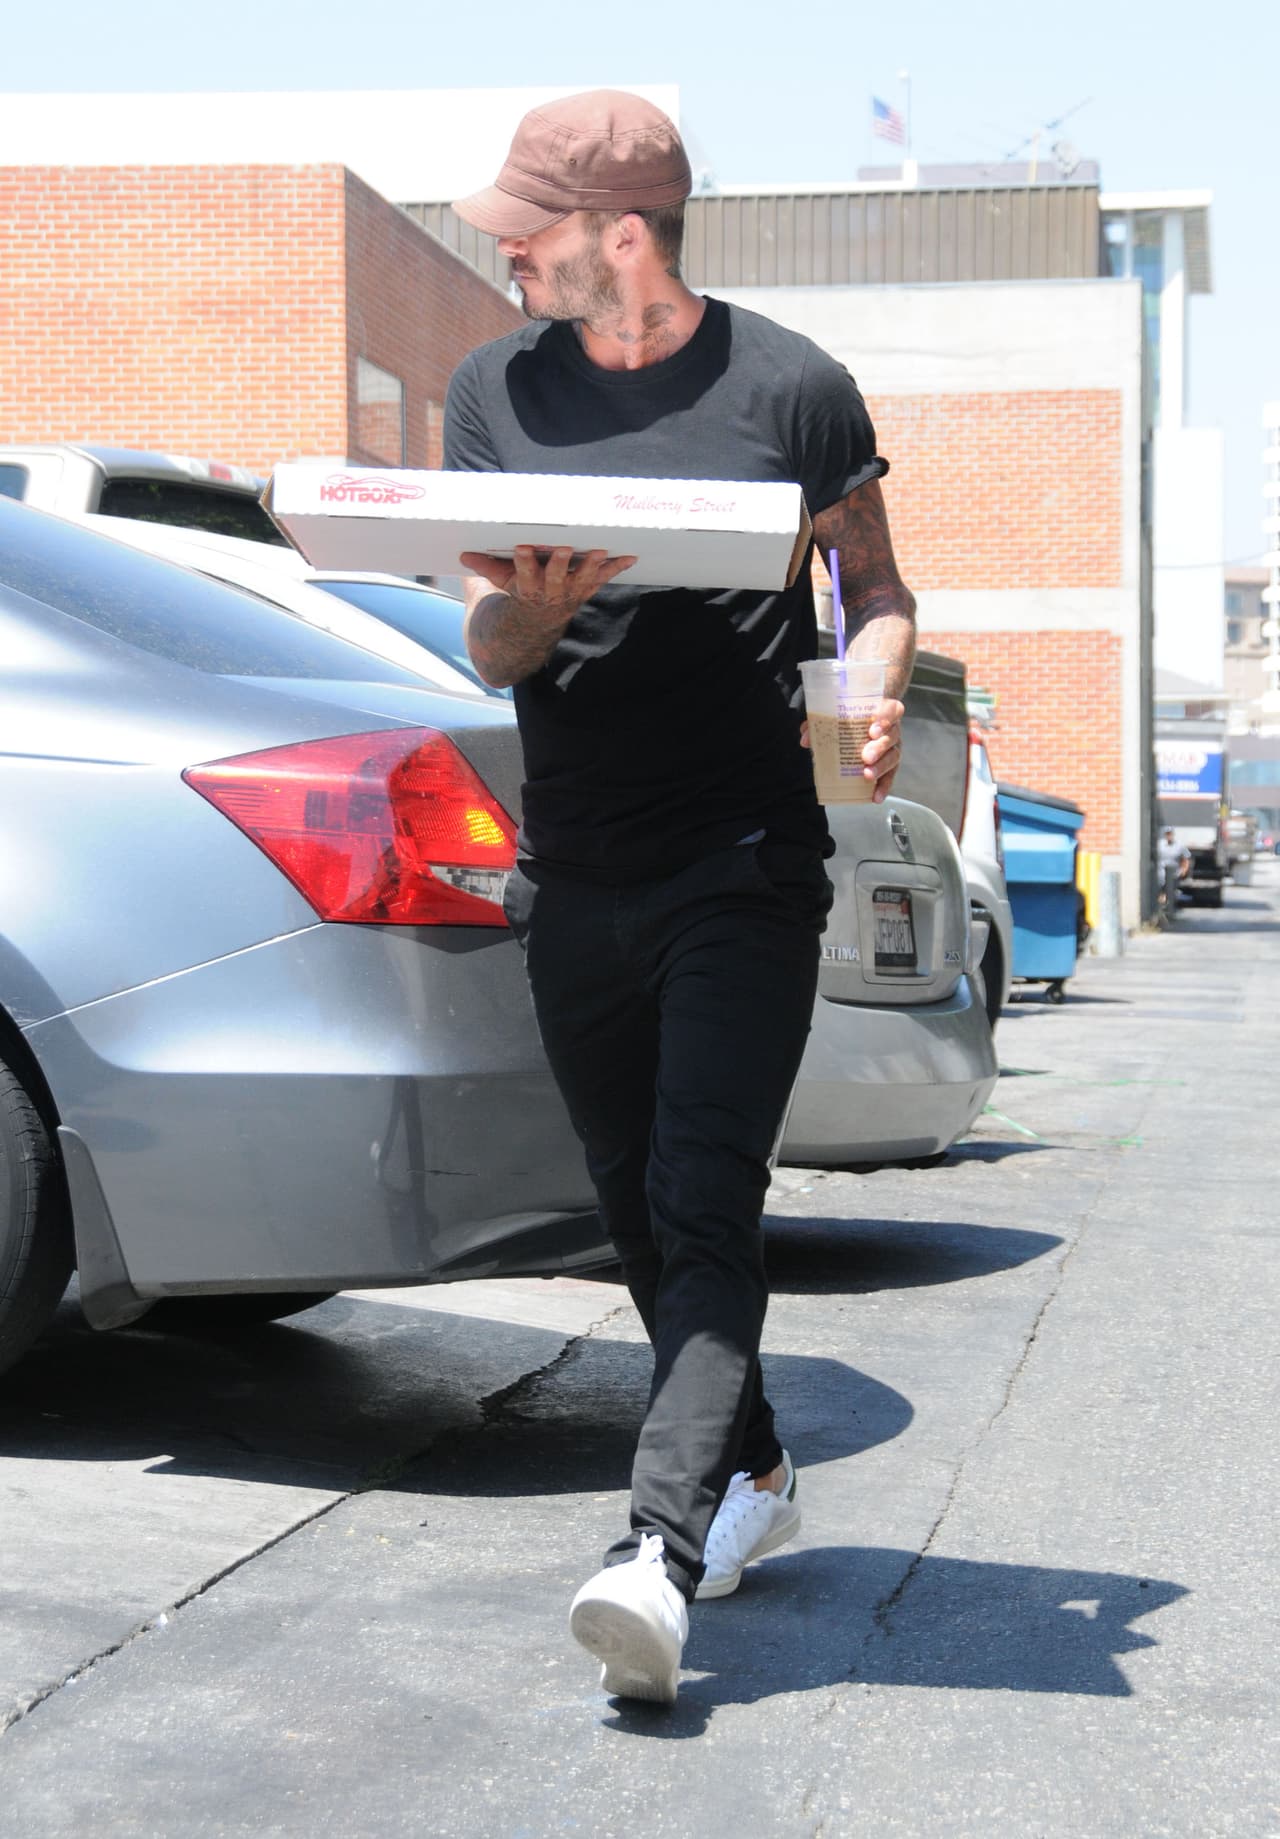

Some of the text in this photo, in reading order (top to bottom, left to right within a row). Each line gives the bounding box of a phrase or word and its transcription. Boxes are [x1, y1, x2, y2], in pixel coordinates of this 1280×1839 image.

[613, 493, 737, 515] Mulberry Street
[823, 946, 860, 961] LTIMA
